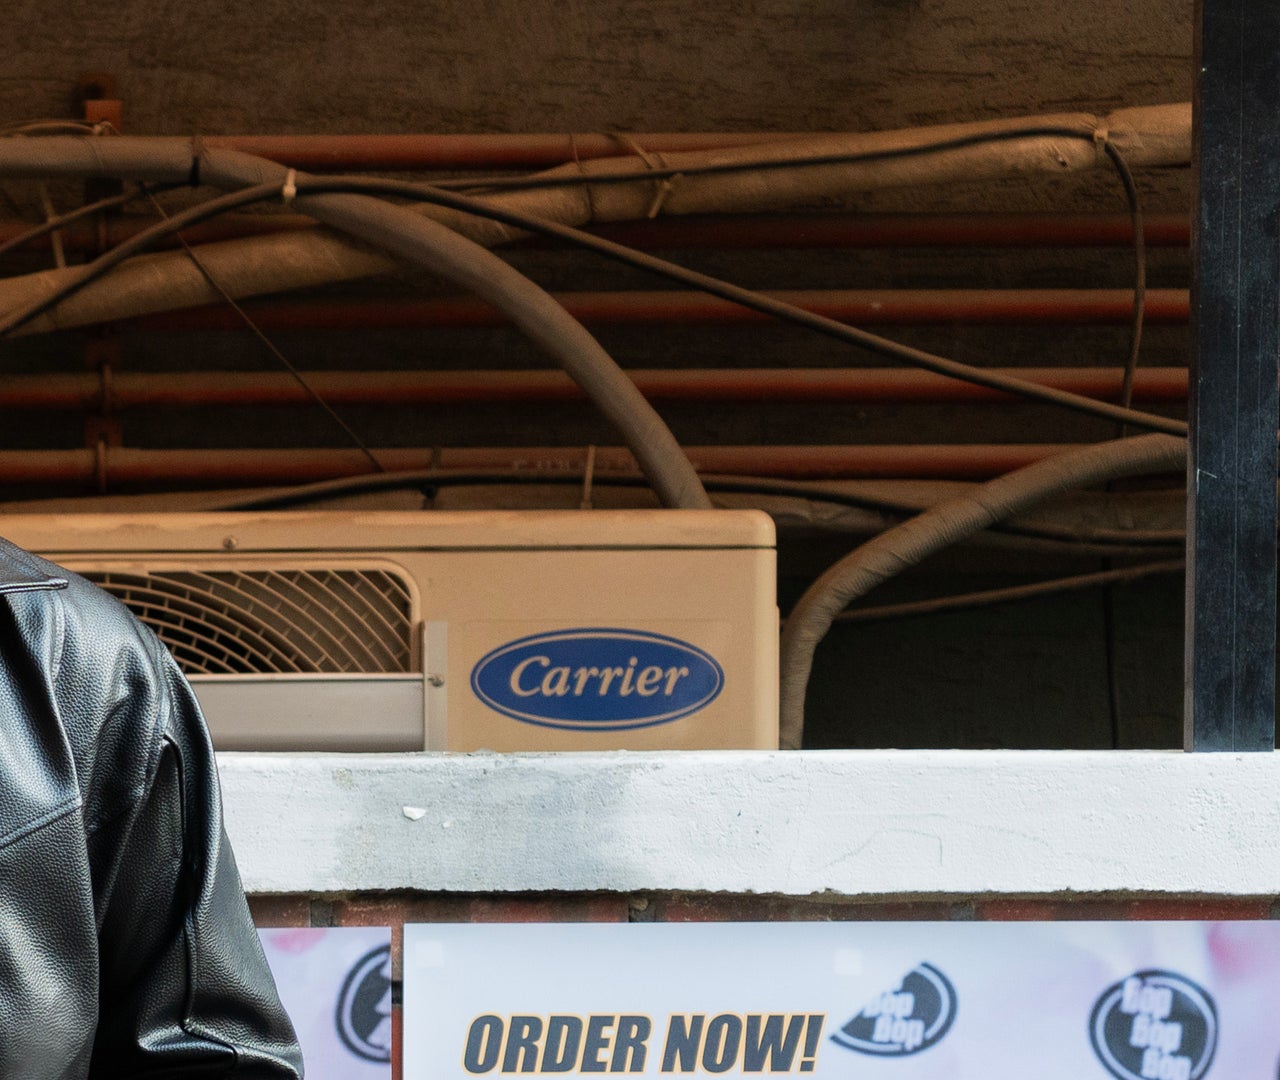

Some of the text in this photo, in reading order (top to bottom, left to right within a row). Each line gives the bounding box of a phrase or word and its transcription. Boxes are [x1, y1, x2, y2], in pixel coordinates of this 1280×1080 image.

[510, 656, 689, 697] Carrier
[463, 1014, 824, 1074] ORDER NOW!
